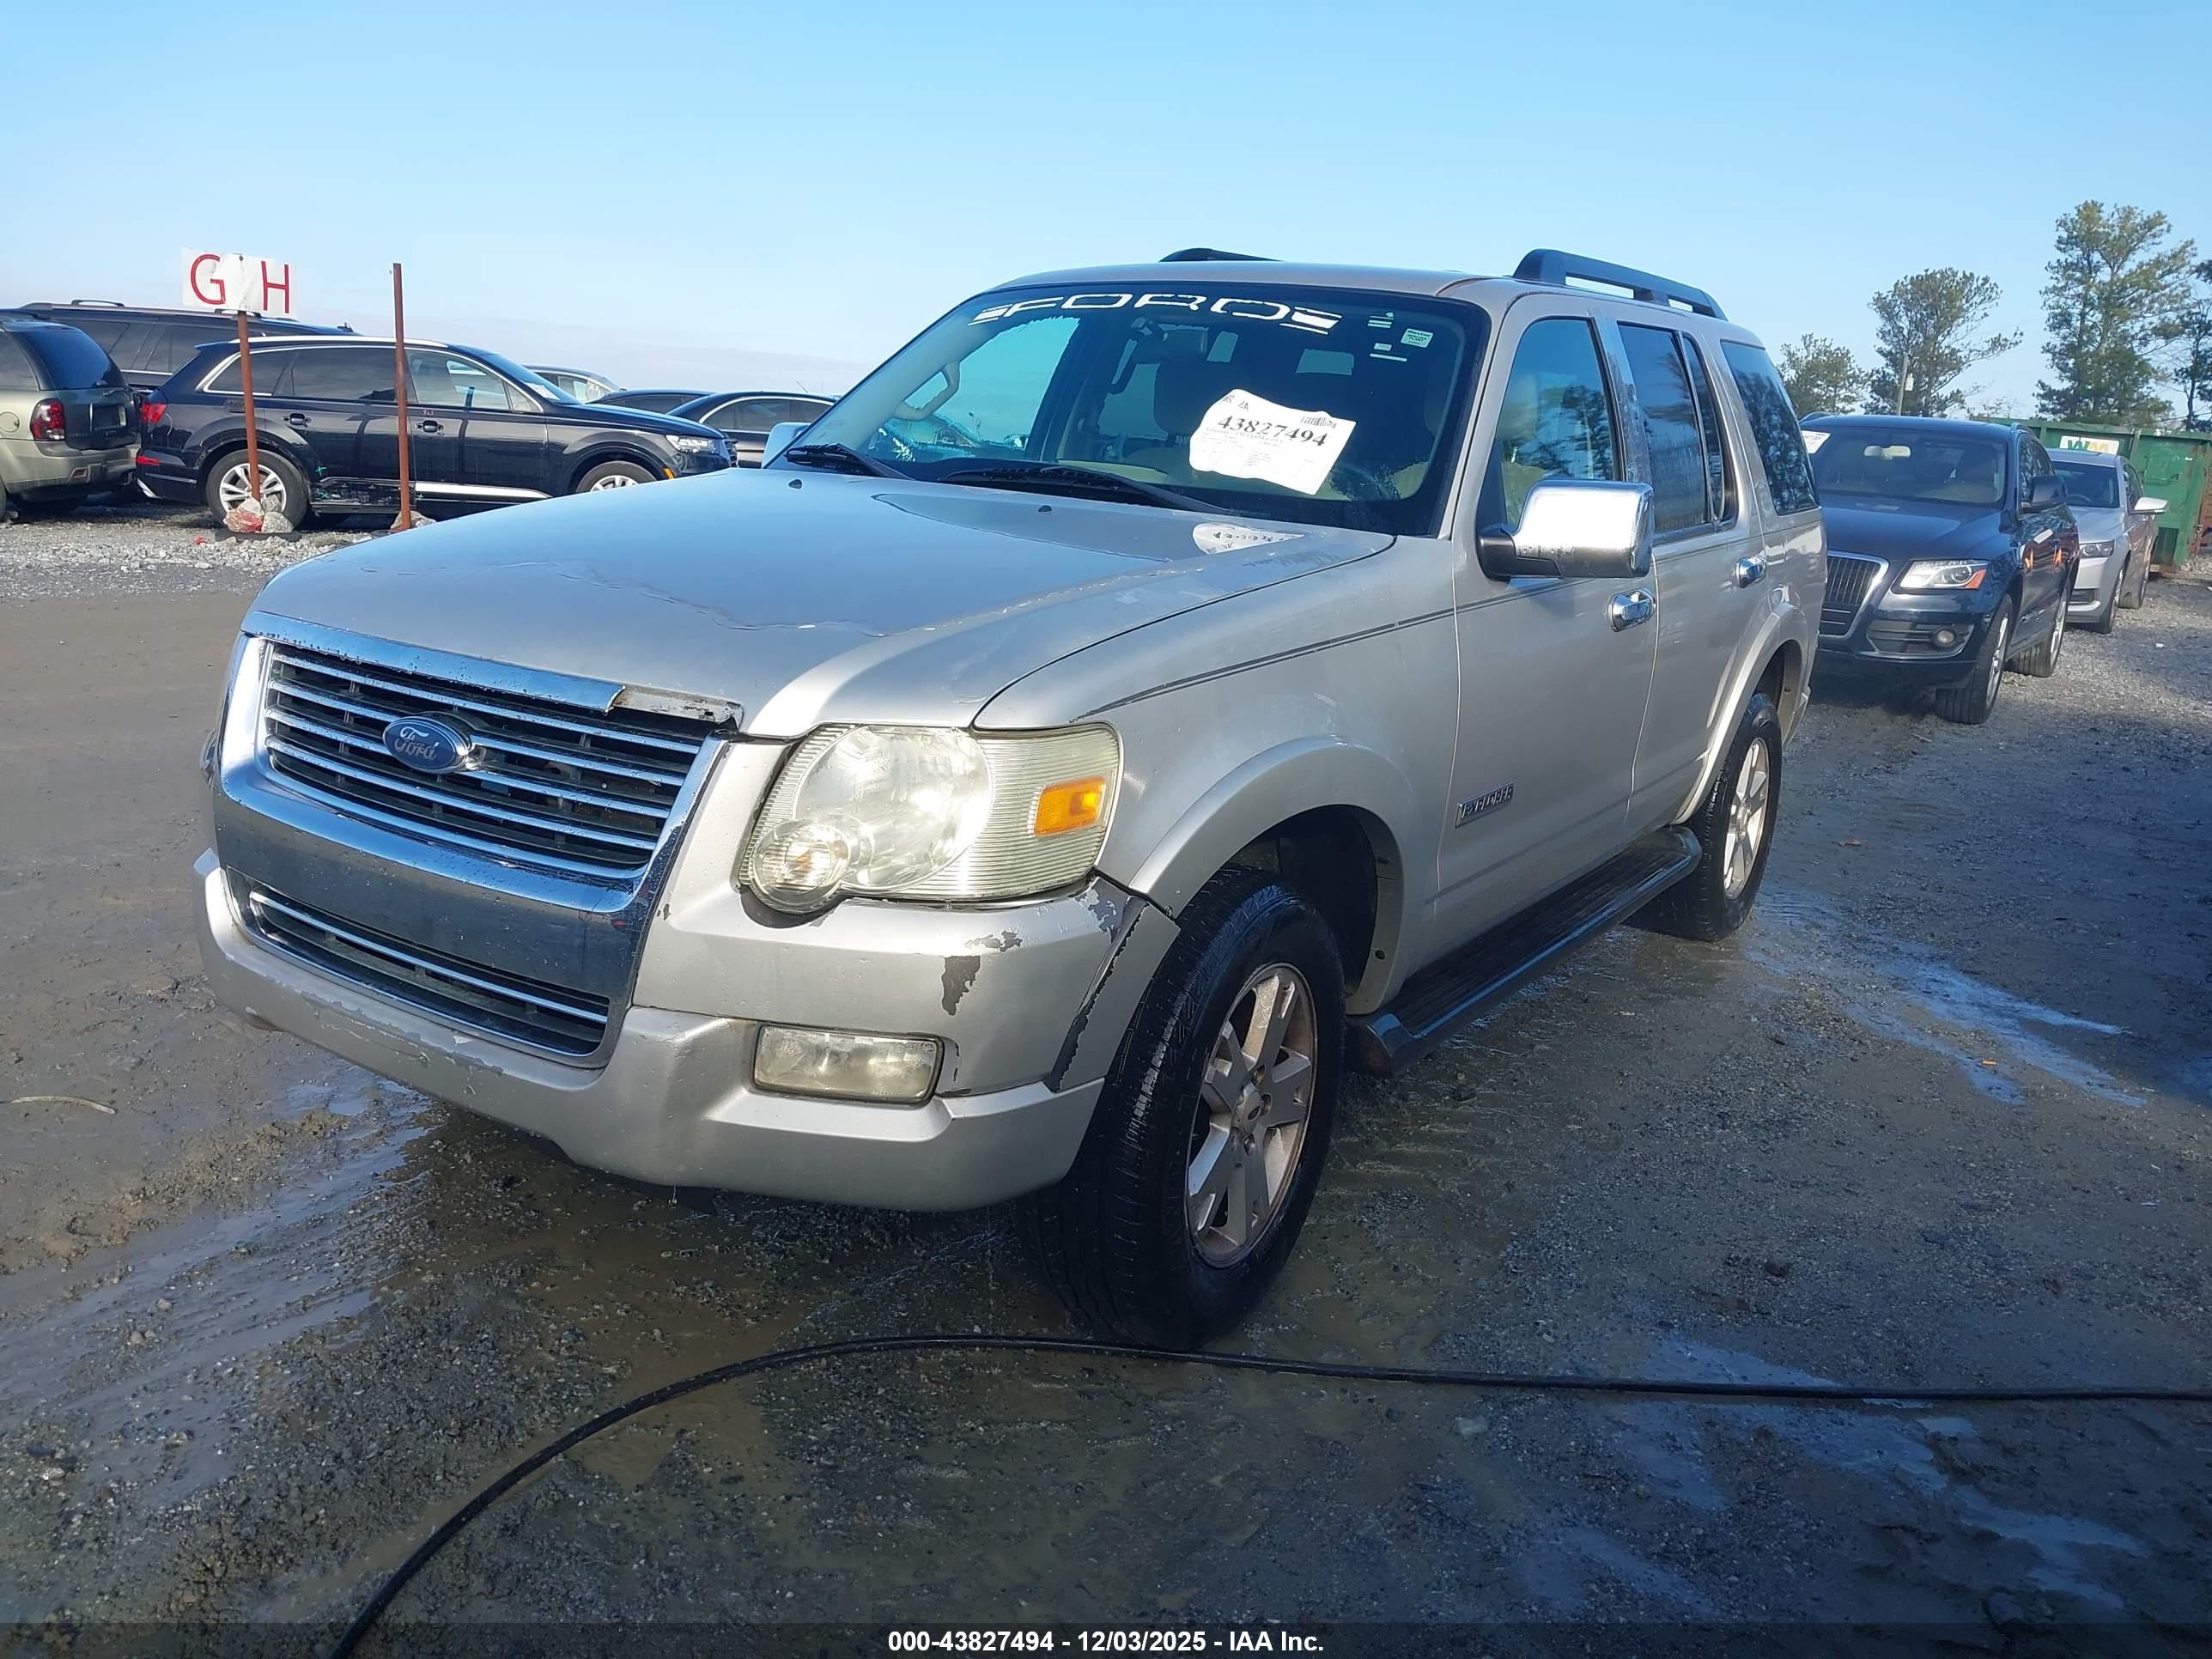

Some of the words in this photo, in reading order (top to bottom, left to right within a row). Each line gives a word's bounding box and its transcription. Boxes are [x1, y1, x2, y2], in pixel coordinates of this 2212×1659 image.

[190, 253, 226, 305] G
[261, 260, 289, 313] H
[1003, 294, 1291, 320] FORD
[1218, 415, 1328, 447] 43827494
[395, 726, 440, 760] Ford
